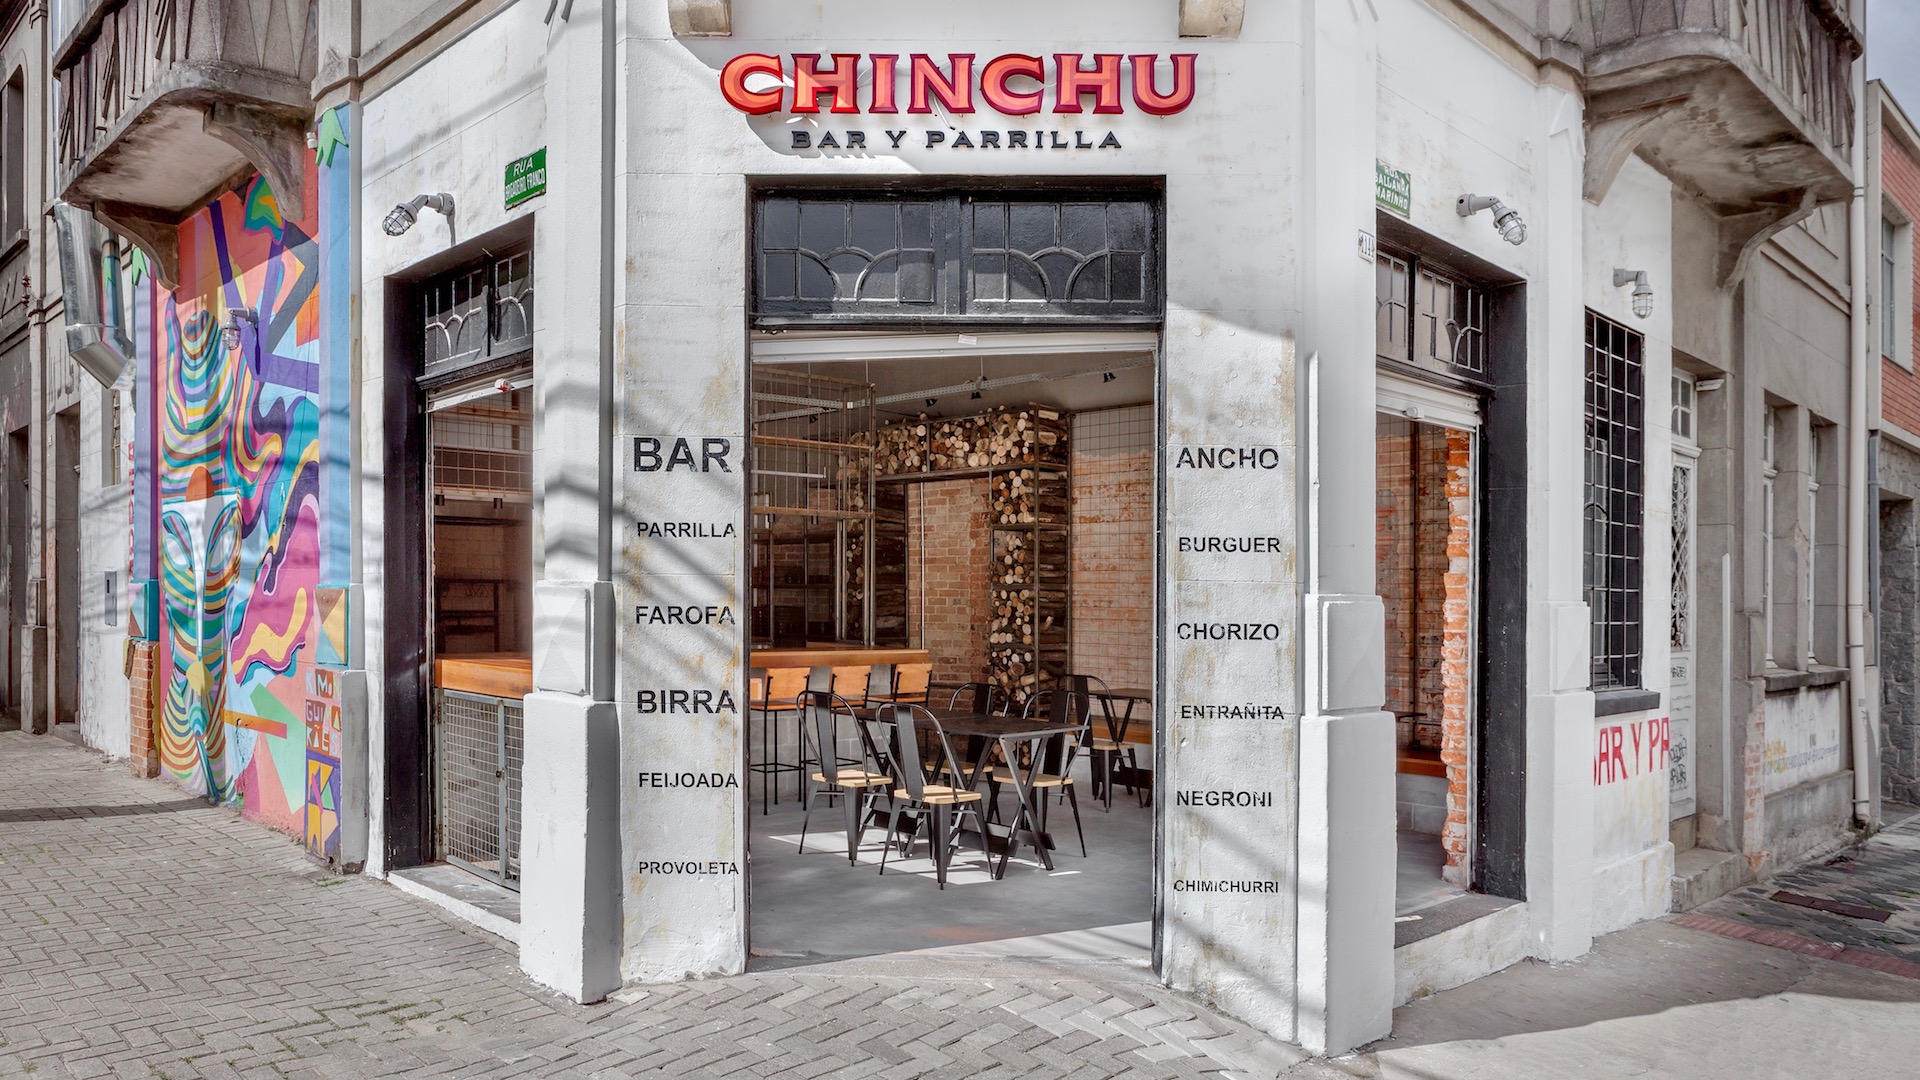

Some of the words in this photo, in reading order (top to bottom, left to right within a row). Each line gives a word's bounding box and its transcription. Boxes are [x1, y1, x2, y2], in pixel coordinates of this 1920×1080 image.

[720, 53, 1198, 116] CHINCHU
[790, 130, 866, 150] BAR
[886, 130, 908, 150] Y
[925, 130, 1124, 150] PARRILLA
[513, 156, 533, 177] RUA
[633, 437, 733, 473] BAR
[1176, 447, 1280, 470] ANCHO
[637, 522, 737, 538] PARRILLA
[1179, 537, 1281, 553] BURGUER
[635, 605, 736, 625] FAROFA
[1177, 622, 1280, 641] CHORIZO
[637, 689, 738, 714] BIRRA
[1181, 702, 1285, 720] ENTRAÑITA
[1593, 725, 1629, 787] AR
[1630, 721, 1643, 777] Y
[1647, 717, 1670, 773] PA
[639, 773, 739, 788] FEIJOADA
[1176, 790, 1272, 808] NEGRONI
[639, 861, 739, 875] PROVOLETA
[1174, 880, 1279, 893] CHIMICHURRI
